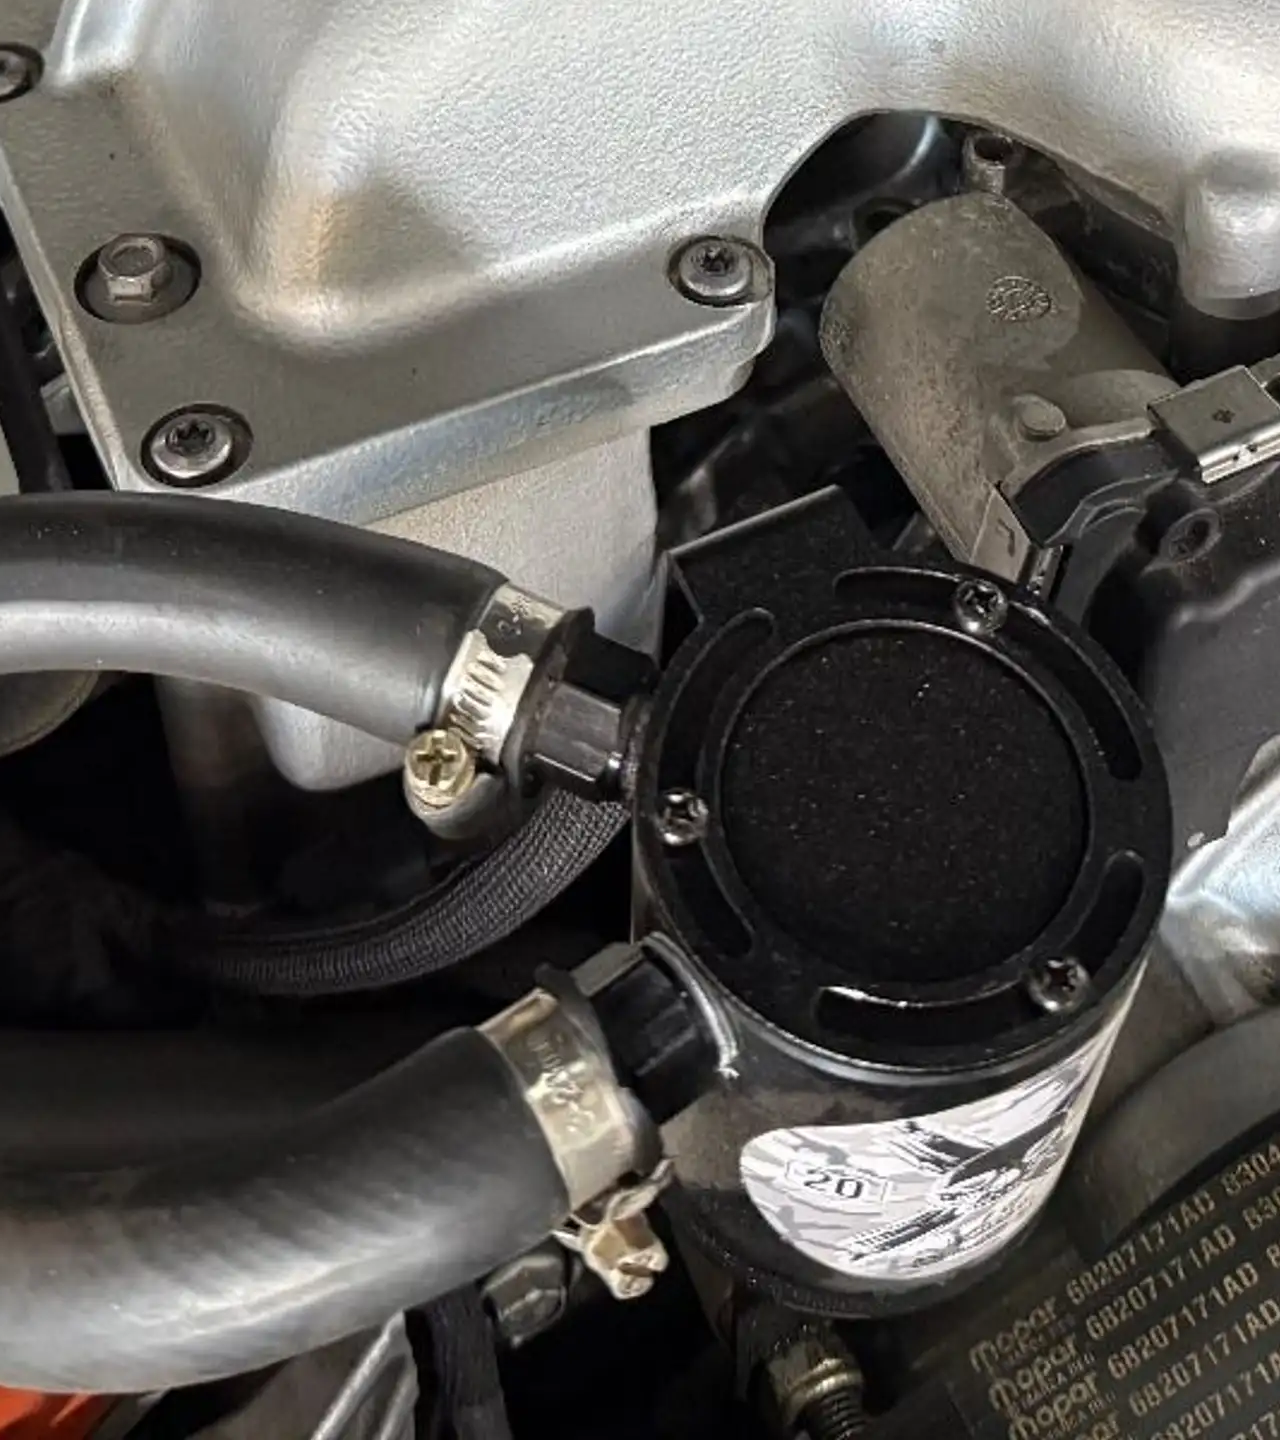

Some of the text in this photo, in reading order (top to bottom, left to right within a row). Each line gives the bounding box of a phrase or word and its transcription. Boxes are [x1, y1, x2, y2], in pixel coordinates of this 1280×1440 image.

[803, 1171, 864, 1200] 20
[1085, 1223, 1237, 1342] 68207171AD
[1107, 1261, 1259, 1380] 68207171AD
